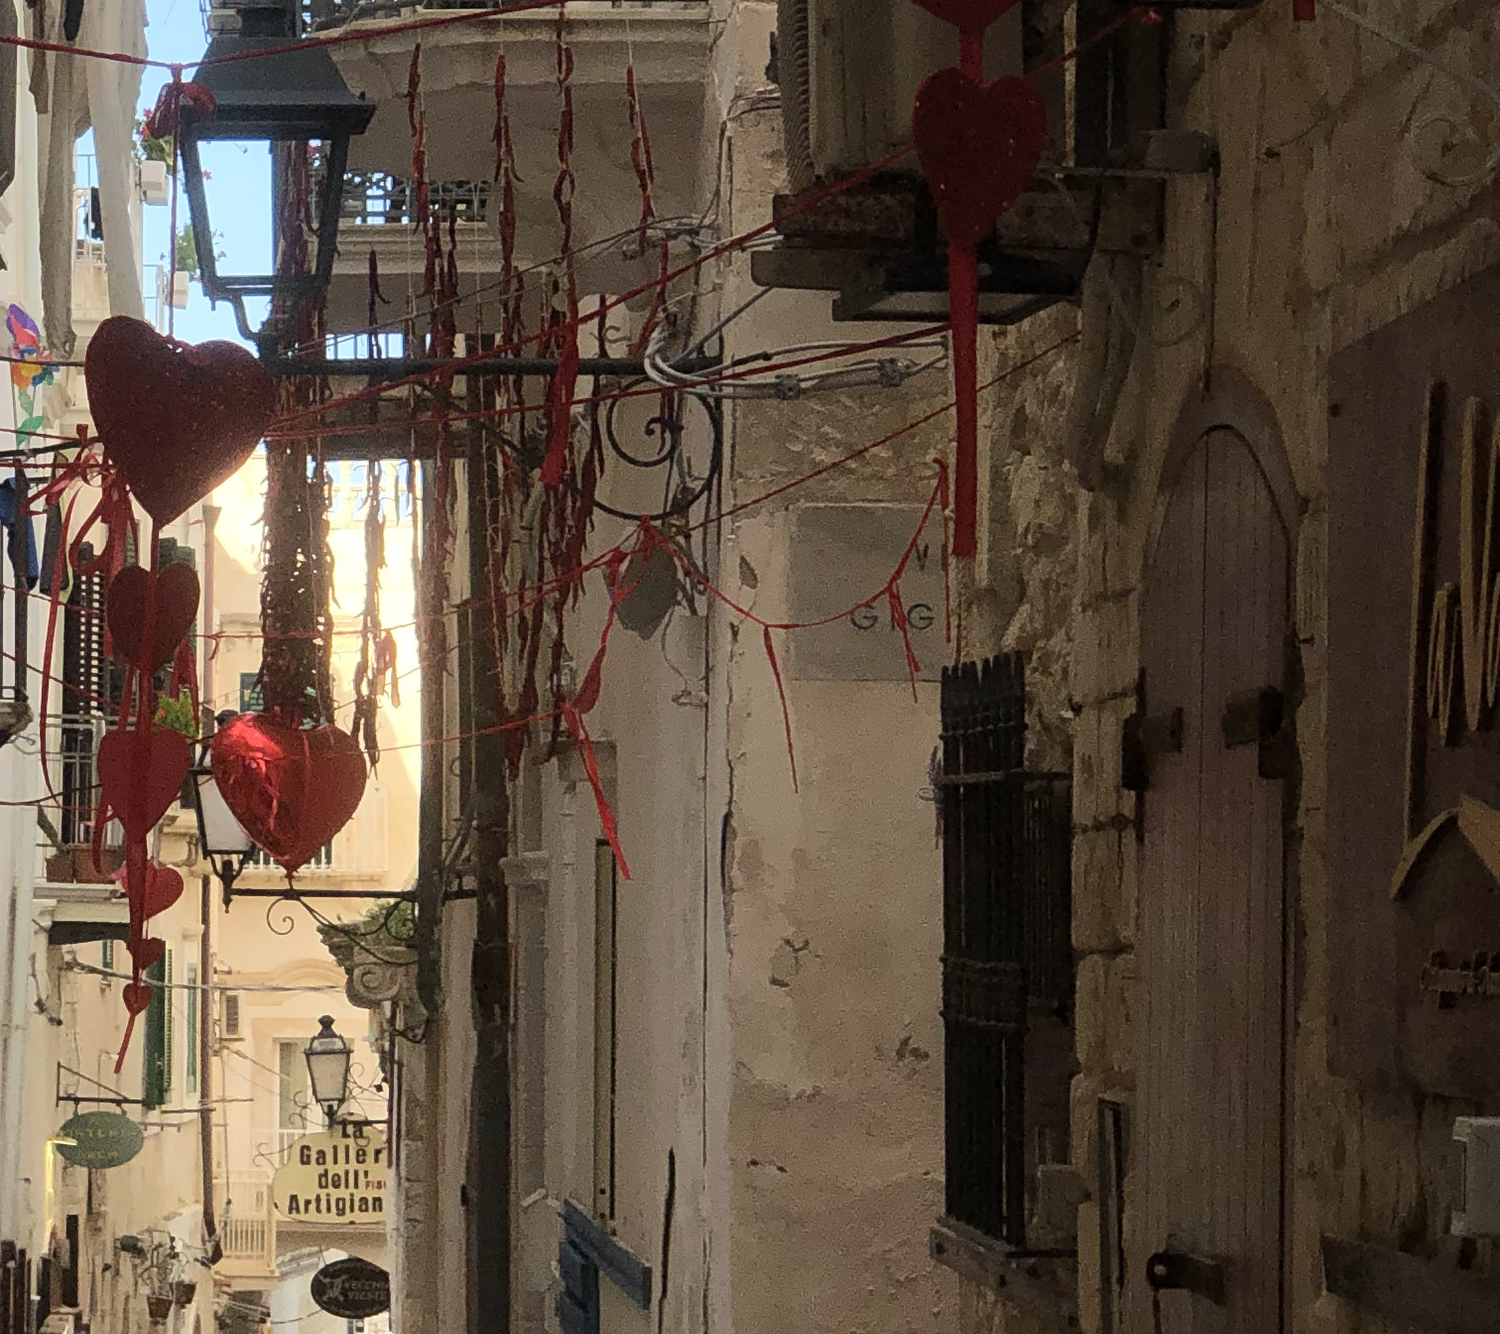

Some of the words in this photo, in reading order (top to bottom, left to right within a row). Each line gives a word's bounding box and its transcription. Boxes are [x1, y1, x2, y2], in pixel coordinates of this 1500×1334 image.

[341, 1118, 364, 1139] La
[299, 1144, 382, 1166] Galler
[317, 1168, 369, 1190] dell'
[287, 1193, 383, 1216] Artigian
